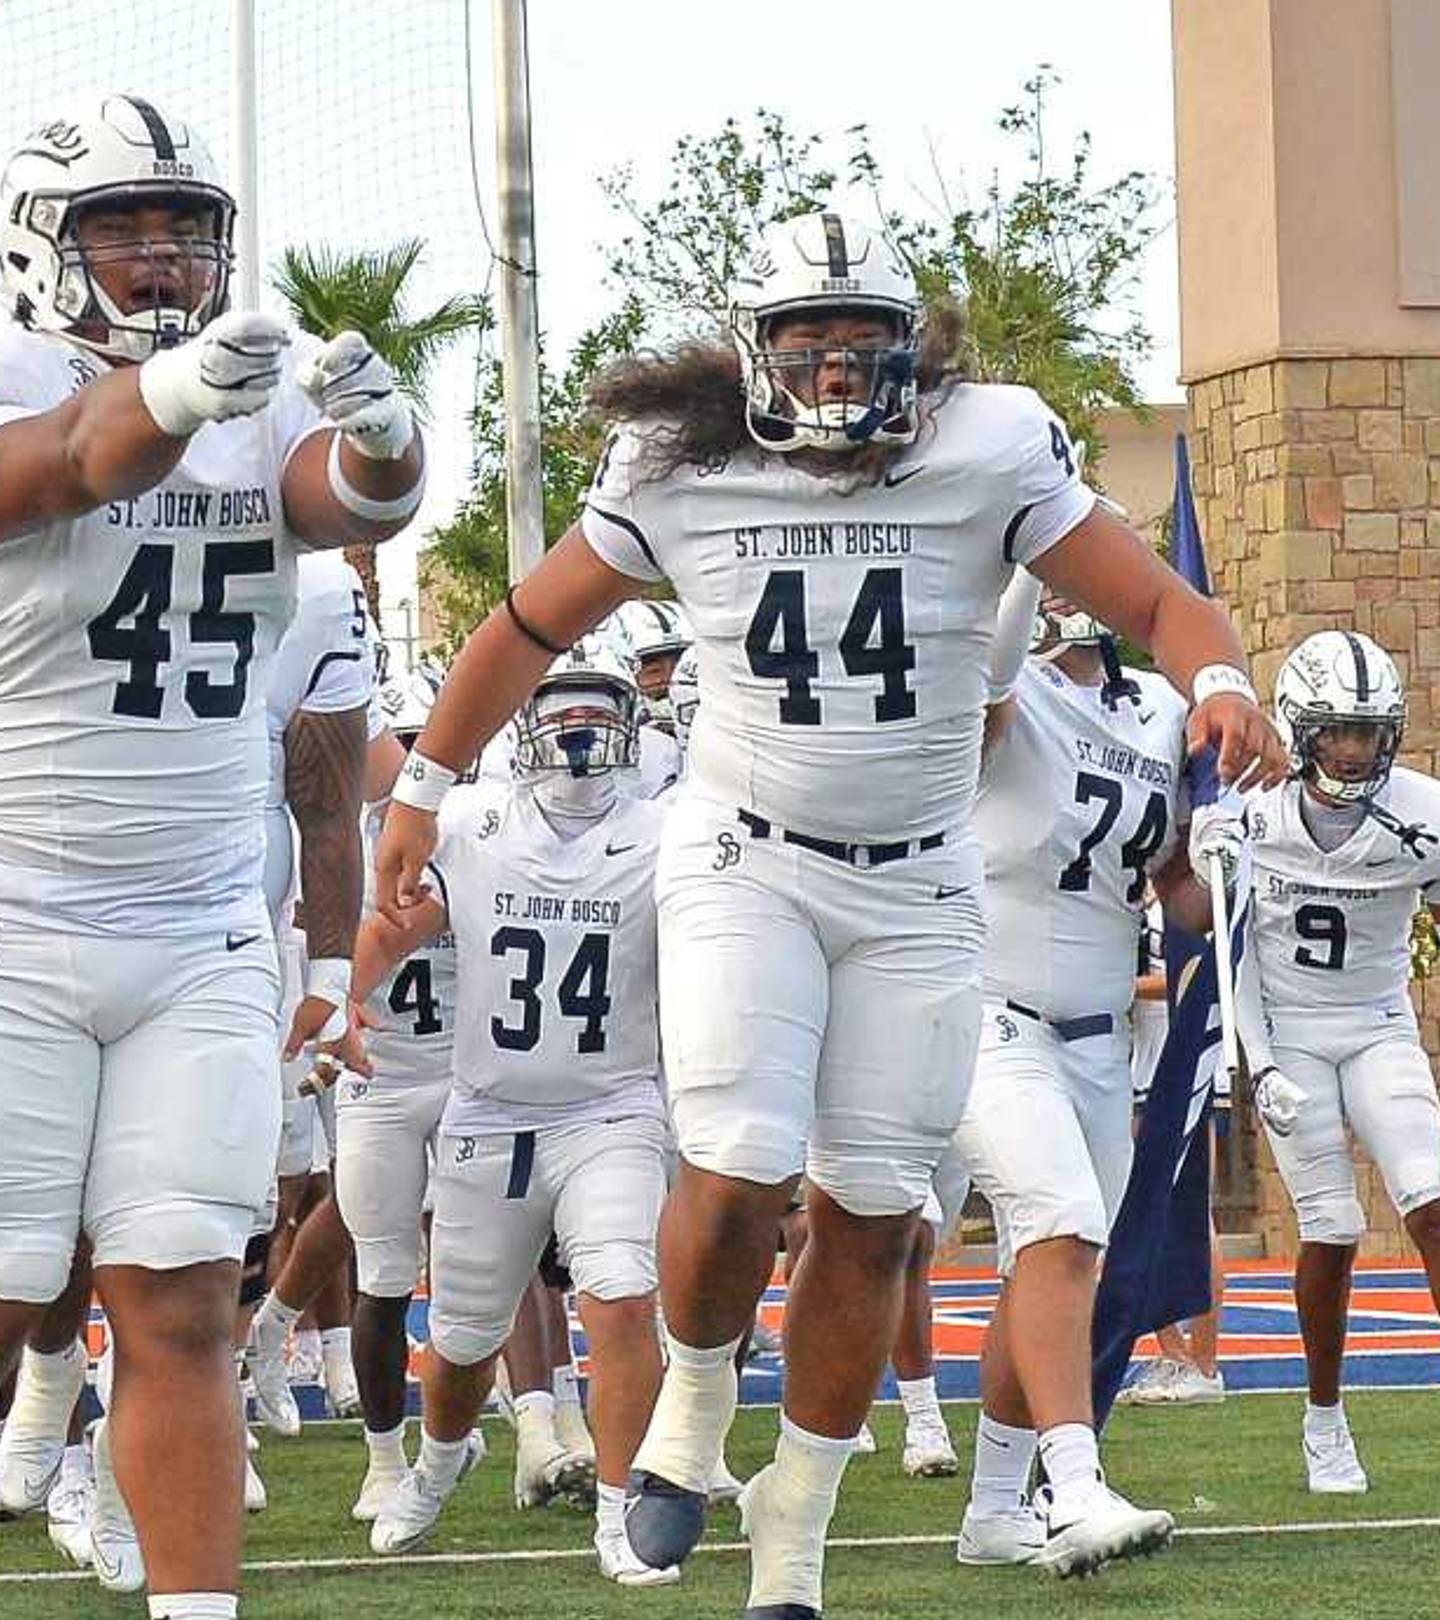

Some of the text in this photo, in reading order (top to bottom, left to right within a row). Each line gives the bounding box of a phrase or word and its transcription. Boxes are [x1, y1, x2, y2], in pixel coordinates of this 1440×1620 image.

[153, 491, 213, 528] JOHN
[734, 523, 912, 557] ST. JOHN BOSCO
[87, 538, 278, 719] 45
[745, 566, 917, 725] 44
[1100, 746, 1137, 776] JOHN
[1059, 771, 1168, 905] 74
[495, 893, 621, 925] ST. JOHN BOSCO
[1294, 904, 1348, 970] 9
[388, 958, 443, 1036] 4
[491, 925, 612, 1054] 34
